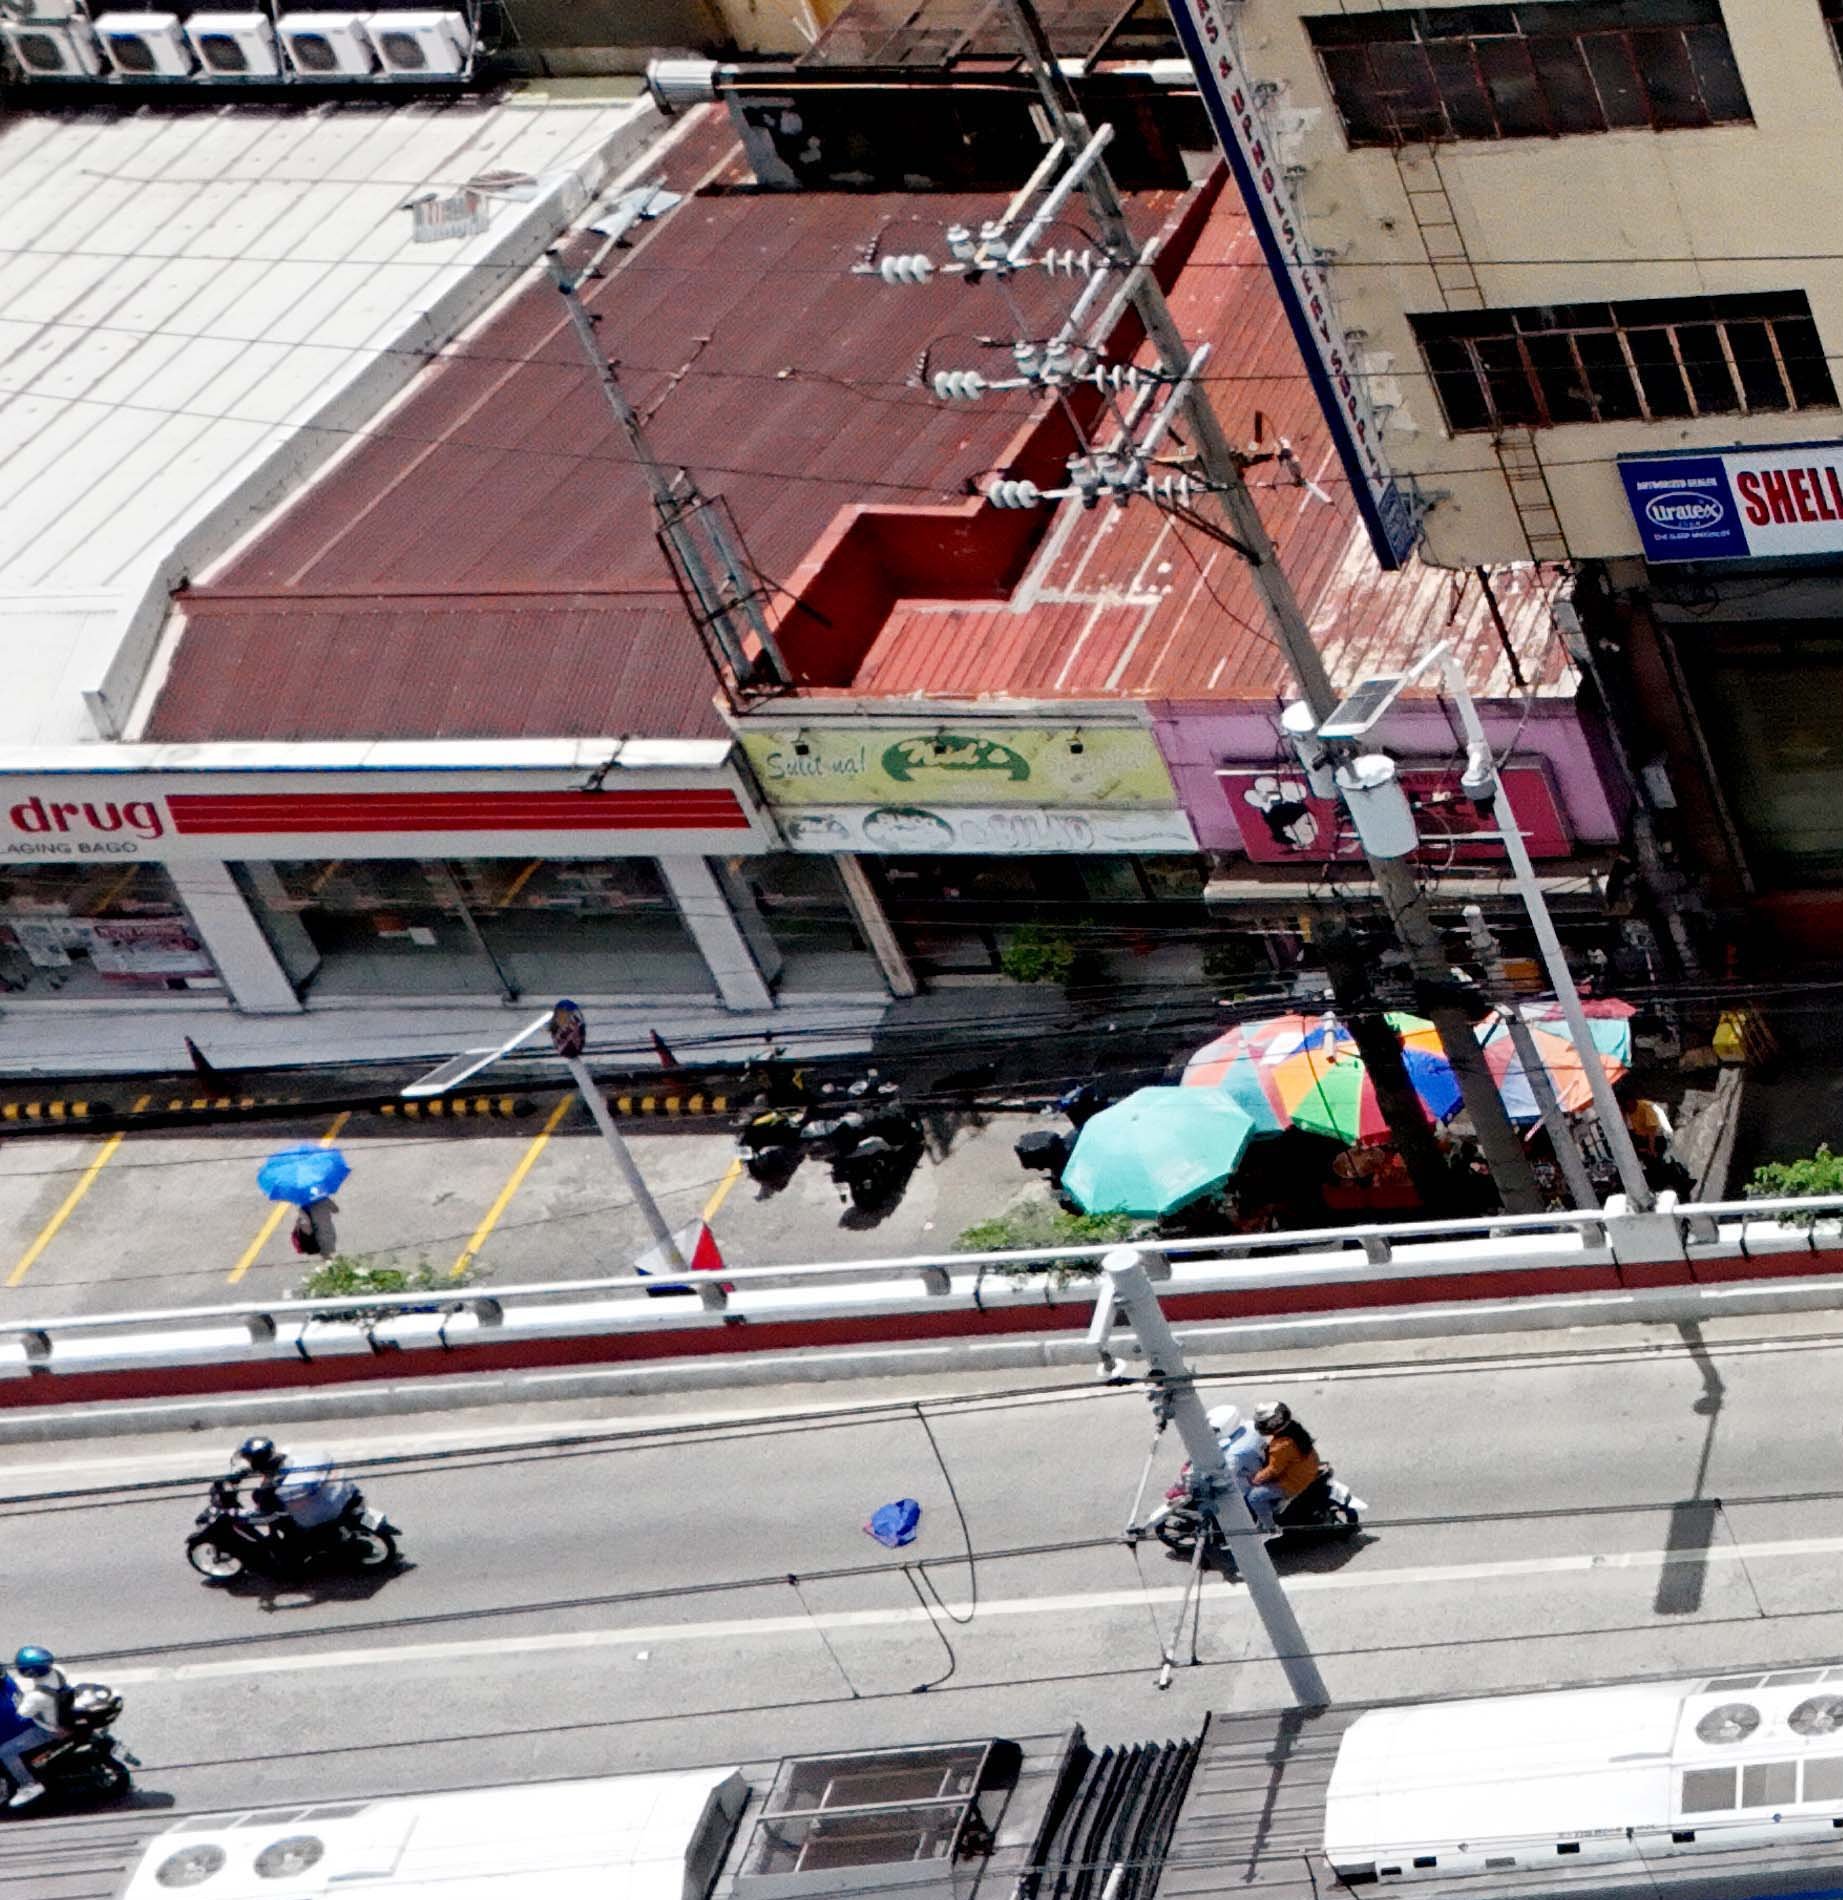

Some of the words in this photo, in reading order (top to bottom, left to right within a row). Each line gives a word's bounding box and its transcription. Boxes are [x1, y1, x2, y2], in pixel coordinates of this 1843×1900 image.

[1651, 503, 1719, 521] Uratex
[9, 796, 164, 840] drug
[0, 842, 73, 855] AGING
[78, 841, 138, 854] BAGO
